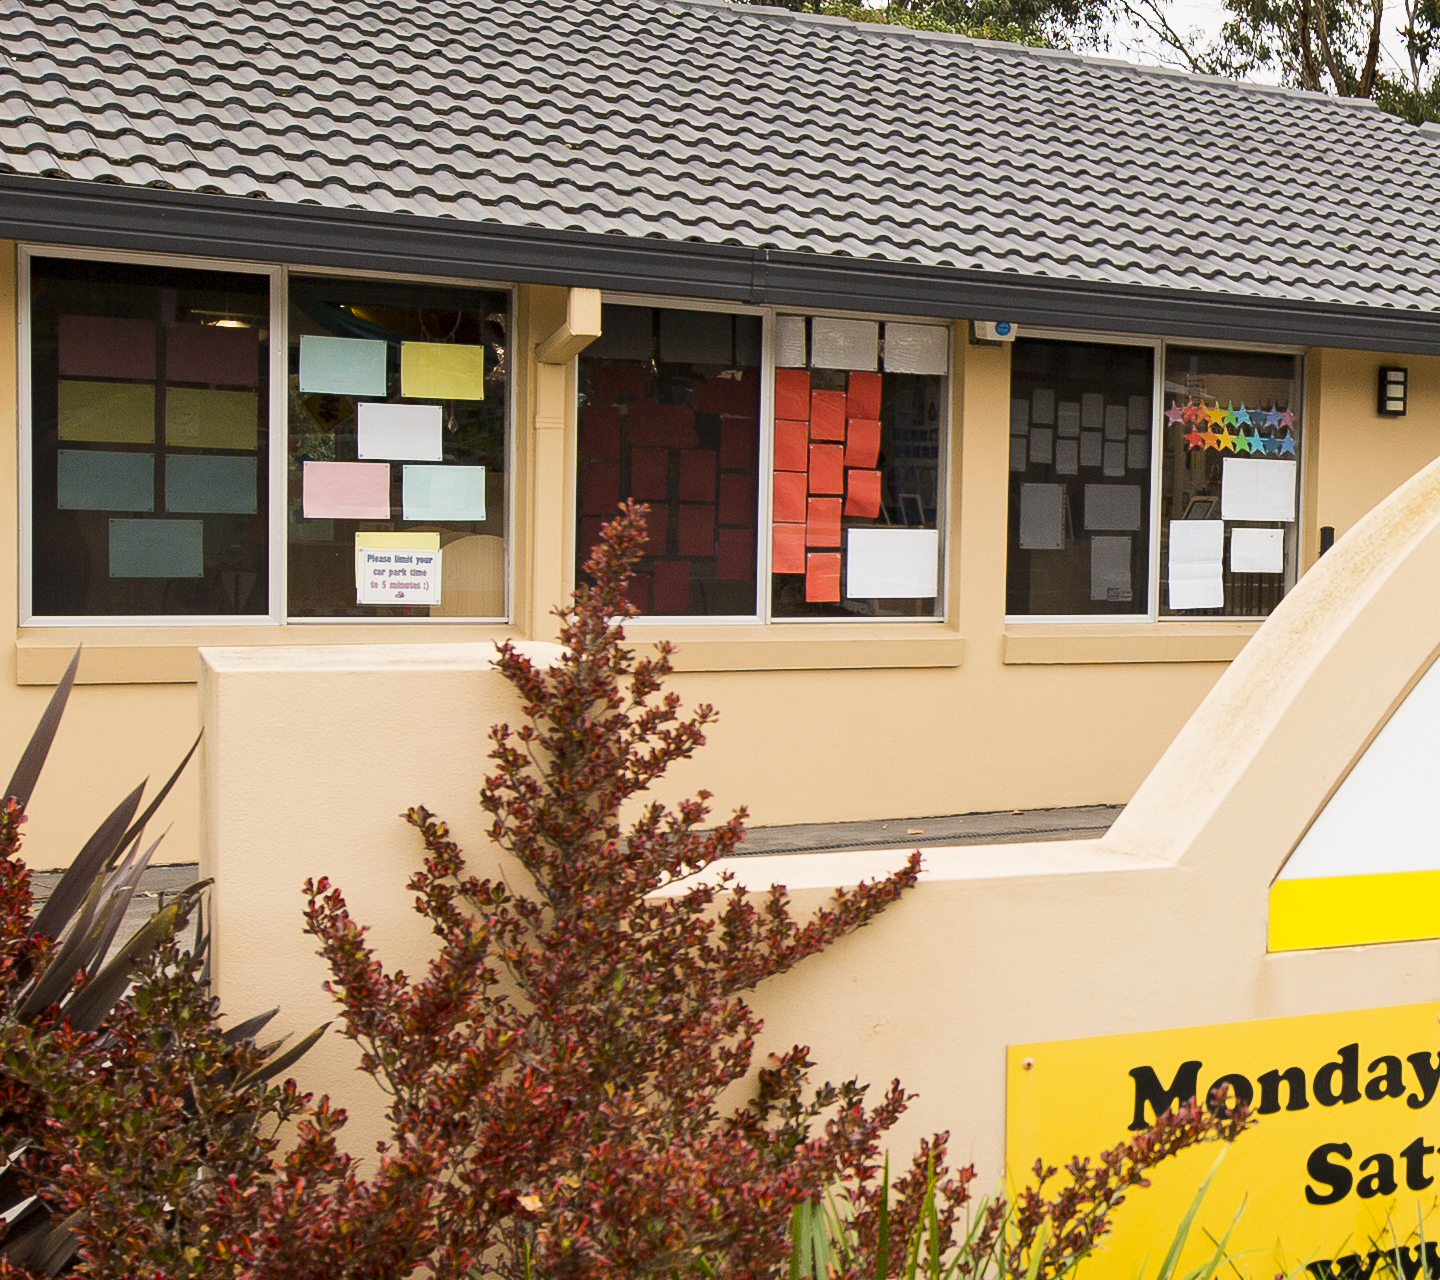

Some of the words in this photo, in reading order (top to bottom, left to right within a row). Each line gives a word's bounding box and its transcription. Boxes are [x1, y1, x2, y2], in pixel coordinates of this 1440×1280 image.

[367, 554, 392, 563] Please
[394, 554, 413, 563] limit
[416, 556, 433, 565] your
[373, 568, 386, 576] car
[388, 568, 407, 577] park
[409, 568, 427, 577] time
[370, 580, 378, 589] to
[381, 580, 387, 589] 5
[389, 581, 421, 589] minutes
